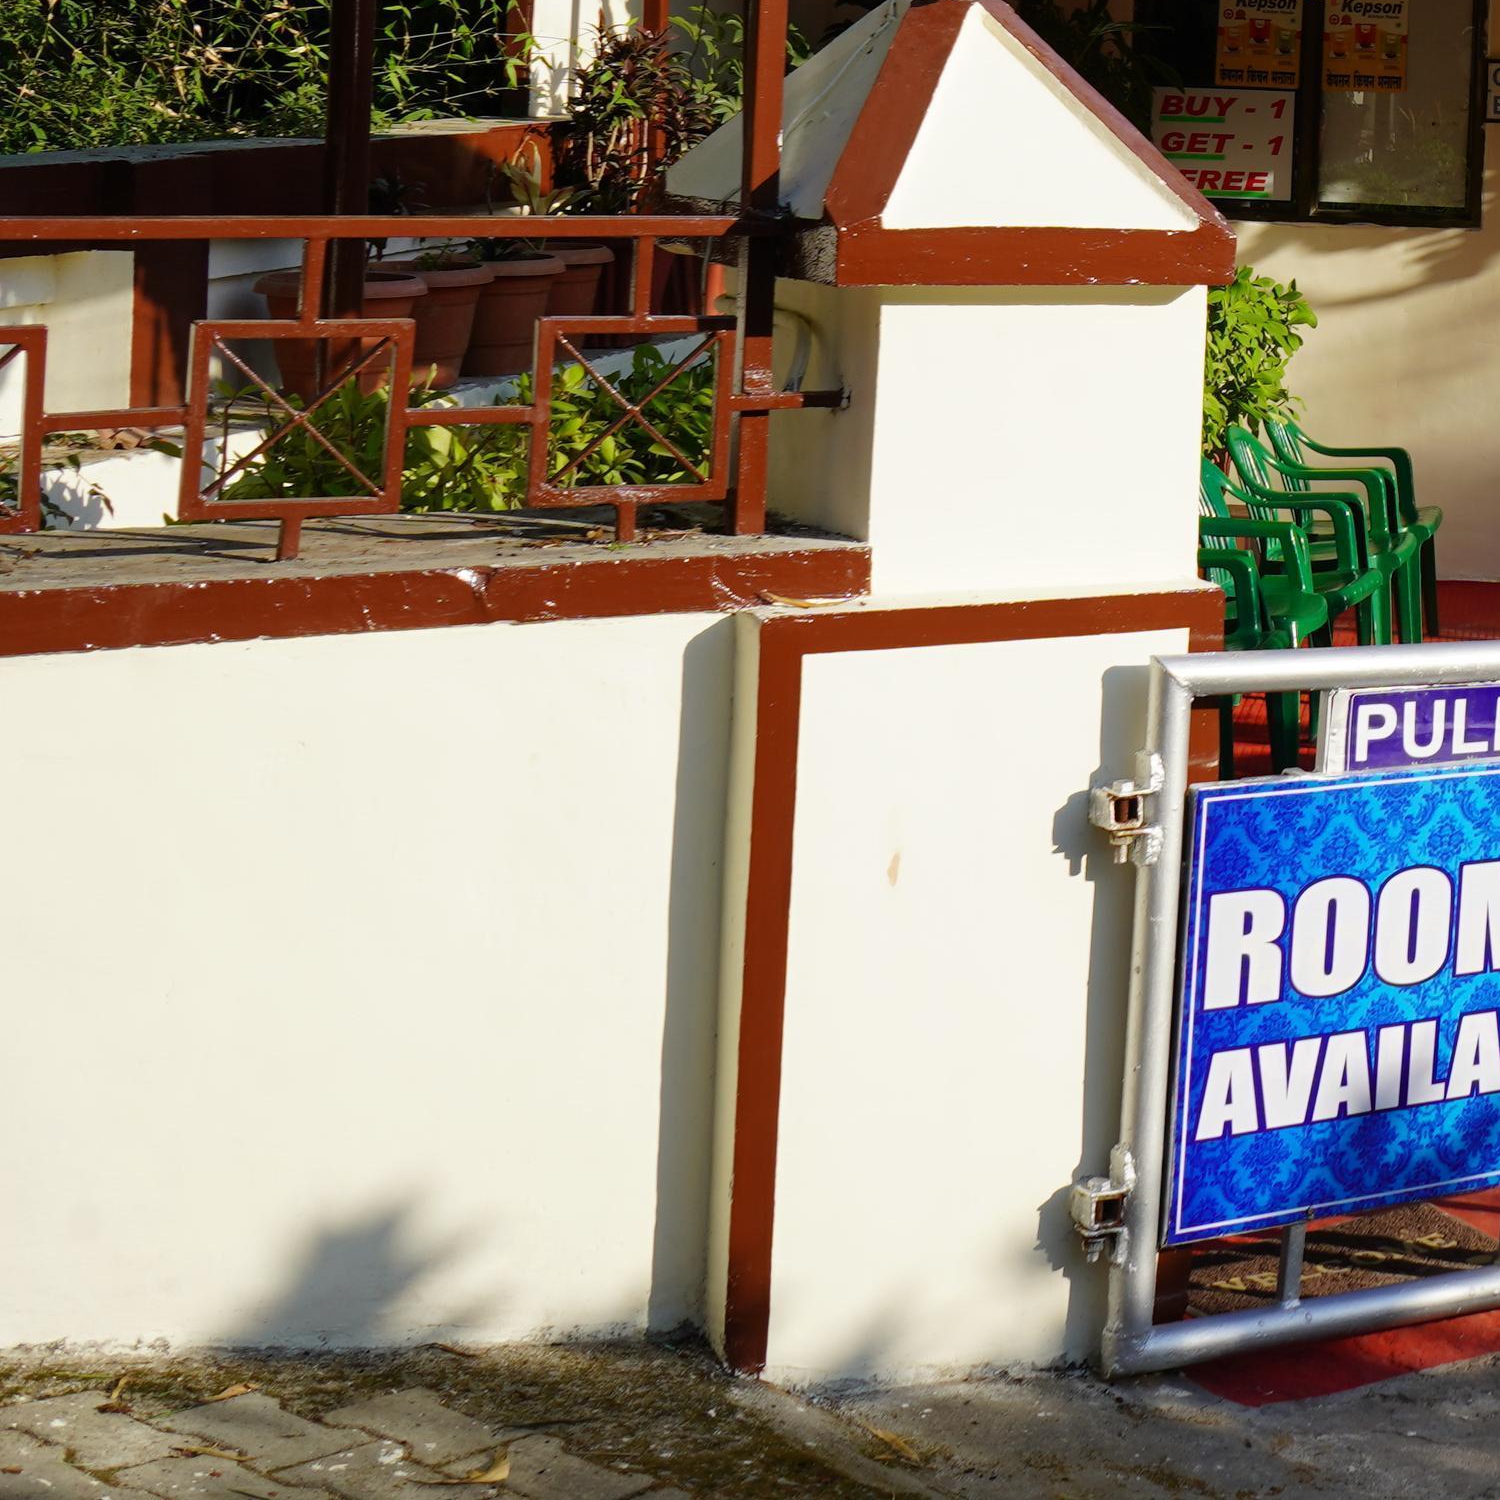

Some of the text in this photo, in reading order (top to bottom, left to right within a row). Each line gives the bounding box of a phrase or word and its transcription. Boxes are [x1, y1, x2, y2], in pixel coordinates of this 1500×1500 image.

[1160, 95, 1239, 116] BUY
[1270, 99, 1286, 119] 1
[1161, 132, 1235, 153] GET
[1268, 136, 1284, 156] 1
